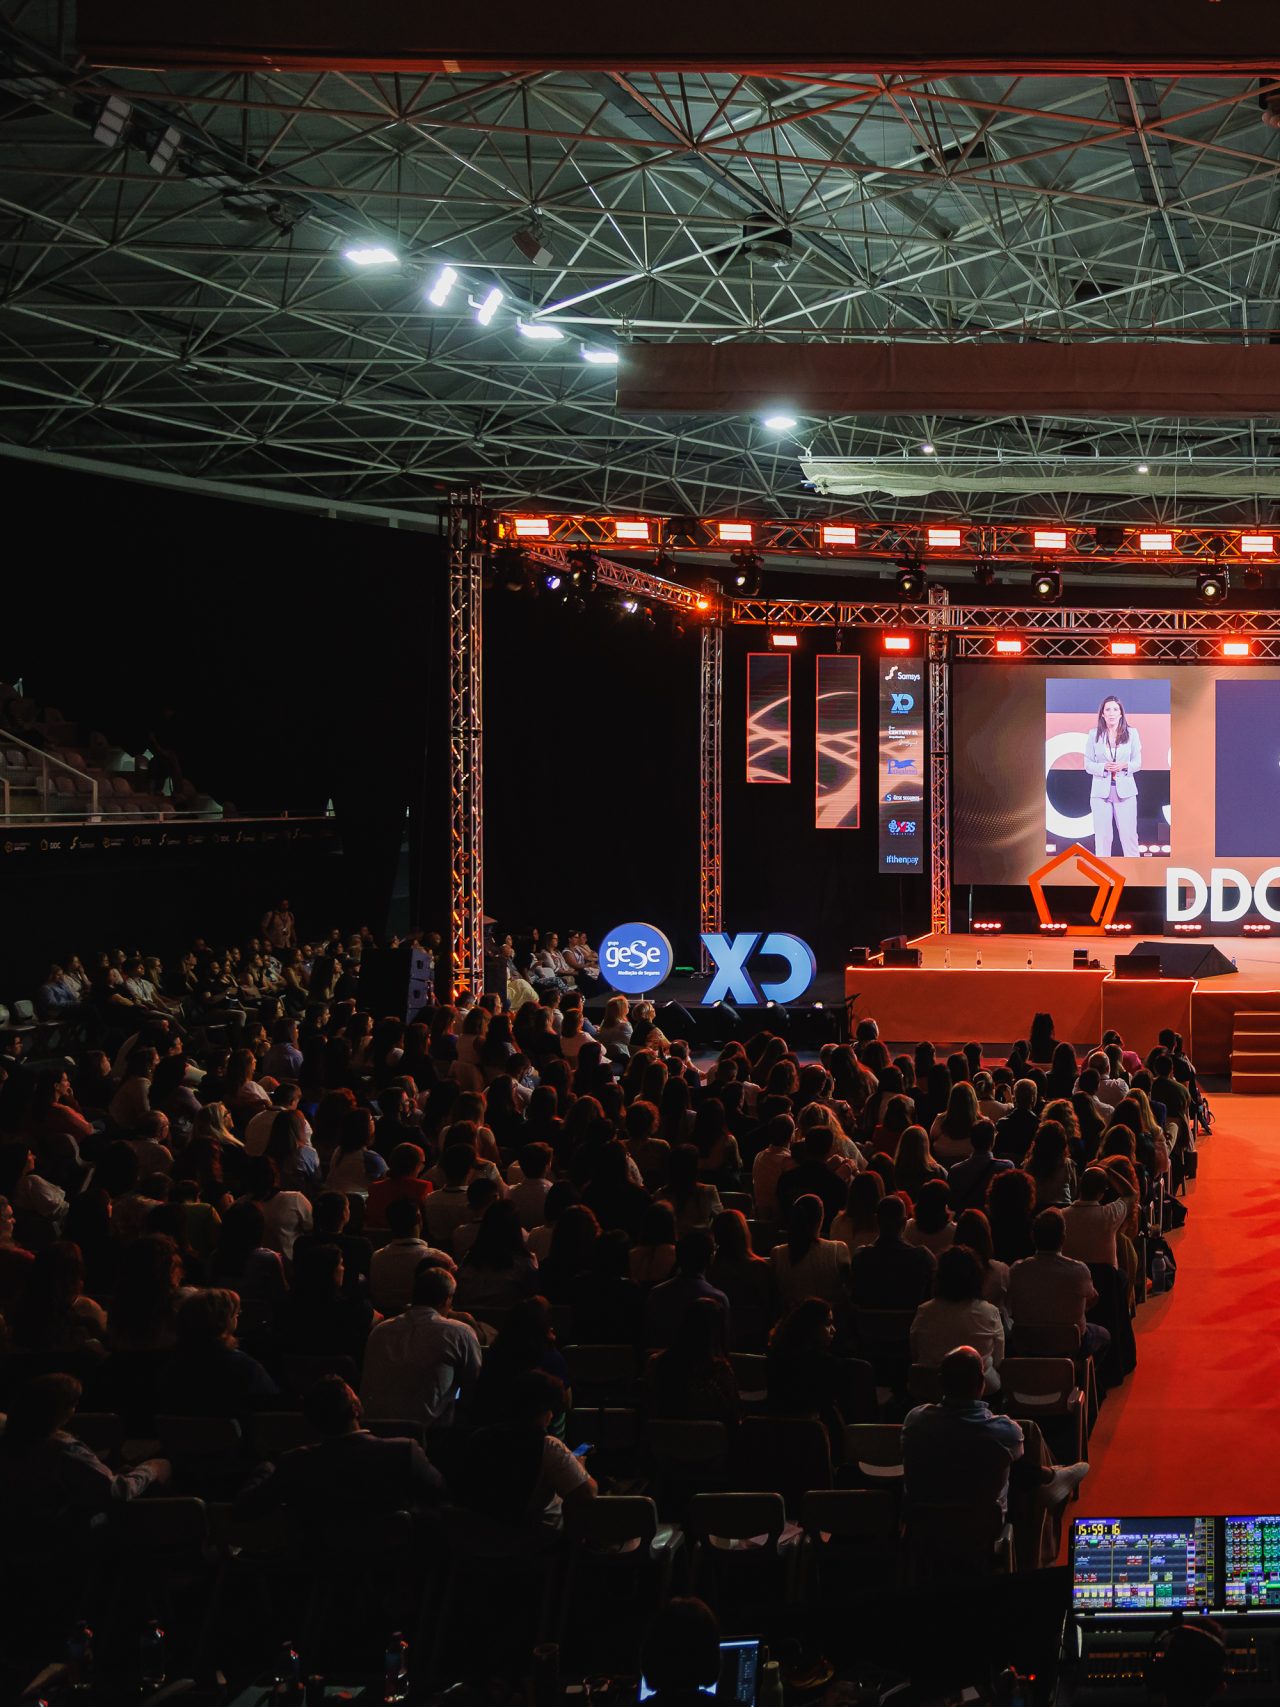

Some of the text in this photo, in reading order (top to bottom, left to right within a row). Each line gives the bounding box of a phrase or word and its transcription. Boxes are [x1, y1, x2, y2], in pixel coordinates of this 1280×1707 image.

[897, 671, 921, 682] Samsys
[890, 693, 914, 711] XD
[886, 855, 919, 866] ifthenpay
[605, 939, 661, 969] geSe
[700, 932, 817, 1005] XD
